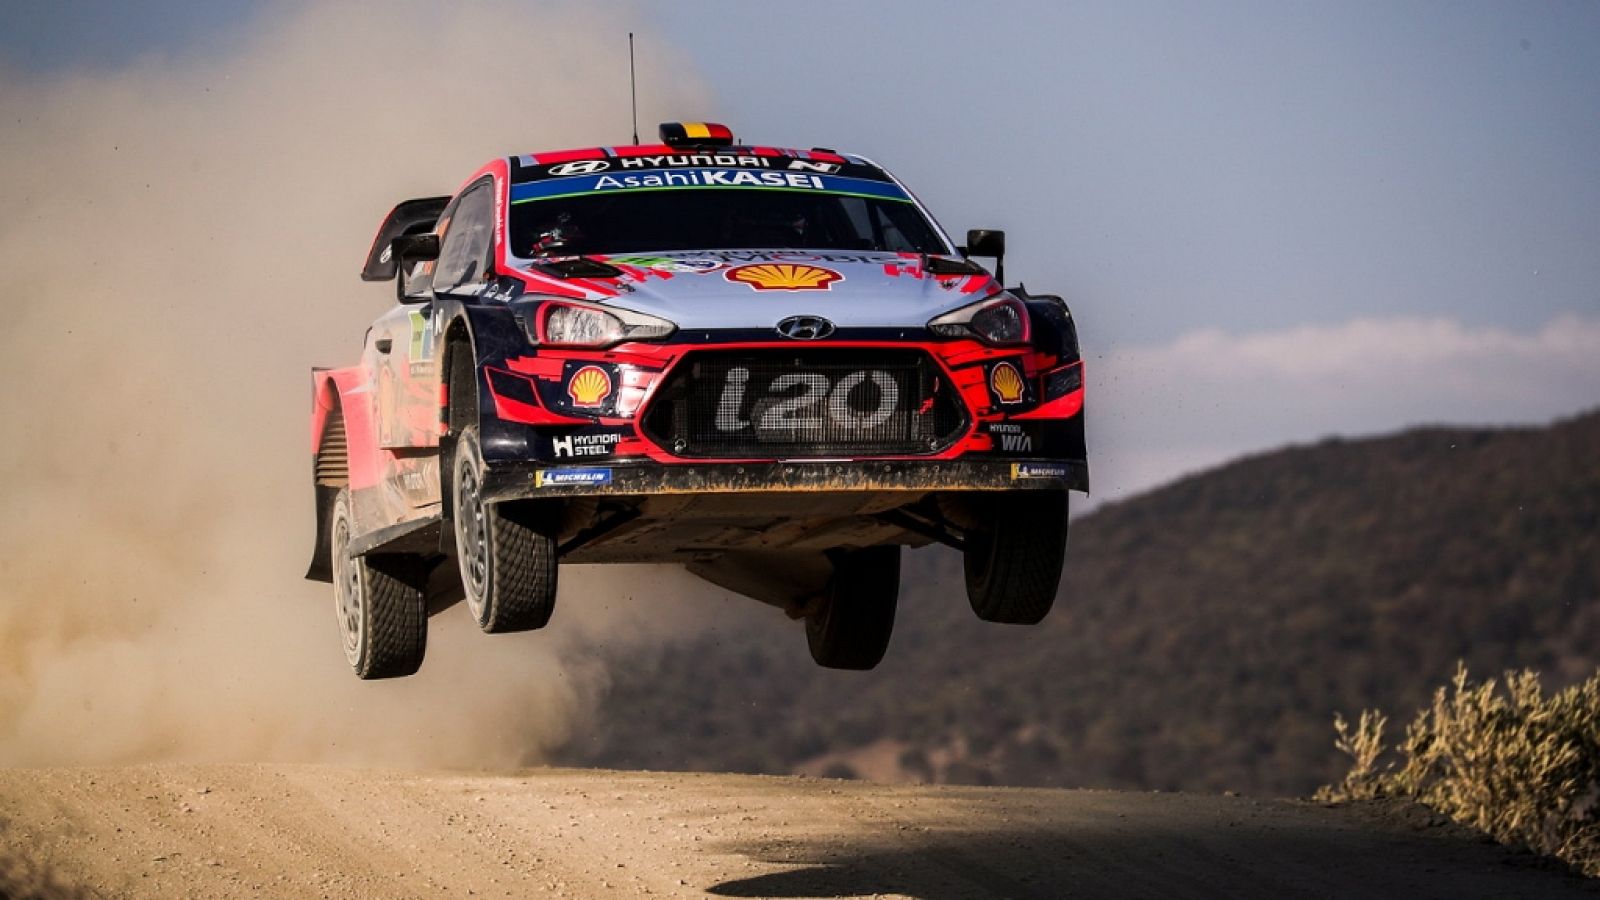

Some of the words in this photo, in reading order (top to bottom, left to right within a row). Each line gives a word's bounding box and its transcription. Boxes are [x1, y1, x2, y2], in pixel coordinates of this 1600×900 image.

[621, 154, 770, 169] HYUNDAI
[715, 367, 899, 431] i20
[989, 423, 1021, 433] HYUNDAI
[574, 433, 621, 444] HYUNDAI
[575, 445, 609, 456] STEEL
[554, 473, 606, 482] MICHELIN
